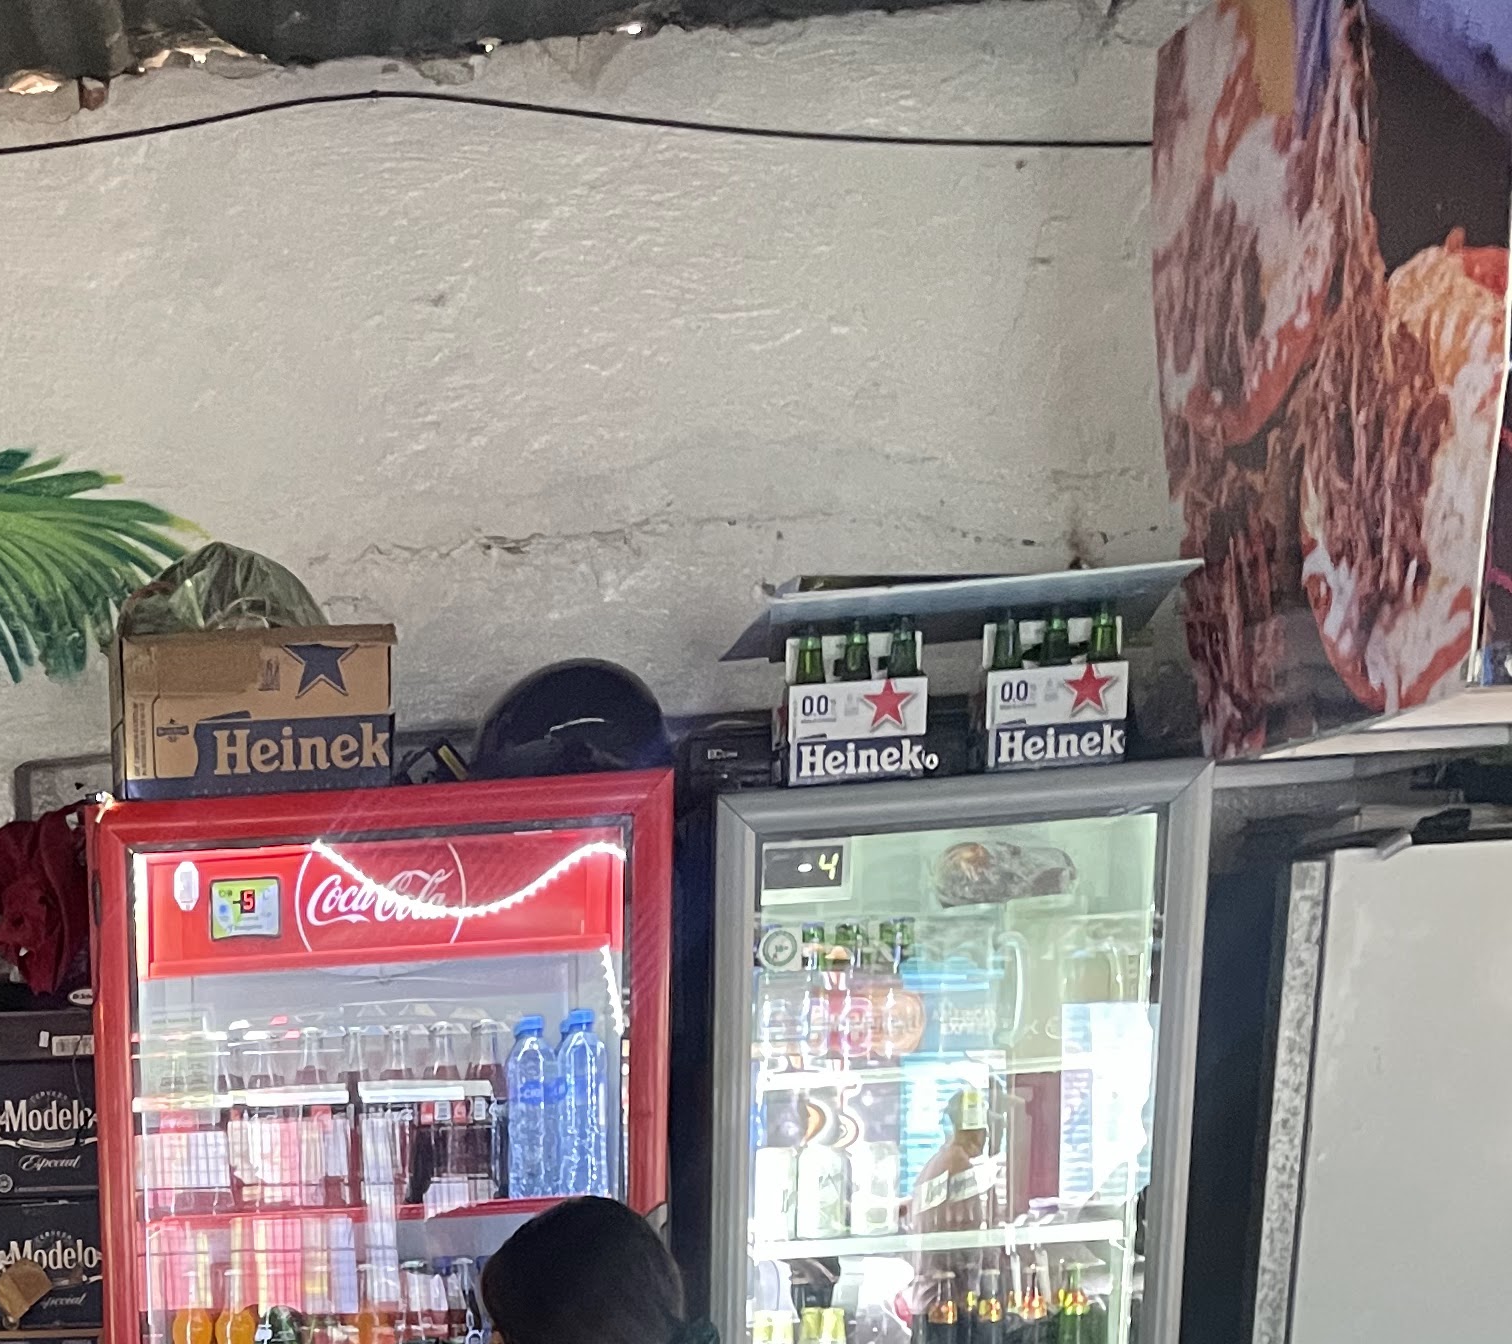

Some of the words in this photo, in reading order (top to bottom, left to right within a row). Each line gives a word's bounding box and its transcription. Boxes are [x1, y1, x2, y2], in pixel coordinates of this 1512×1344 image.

[799, 738, 925, 777] Heinek
[998, 722, 1126, 763] Heinek
[4, 1099, 93, 1133] Modelo
